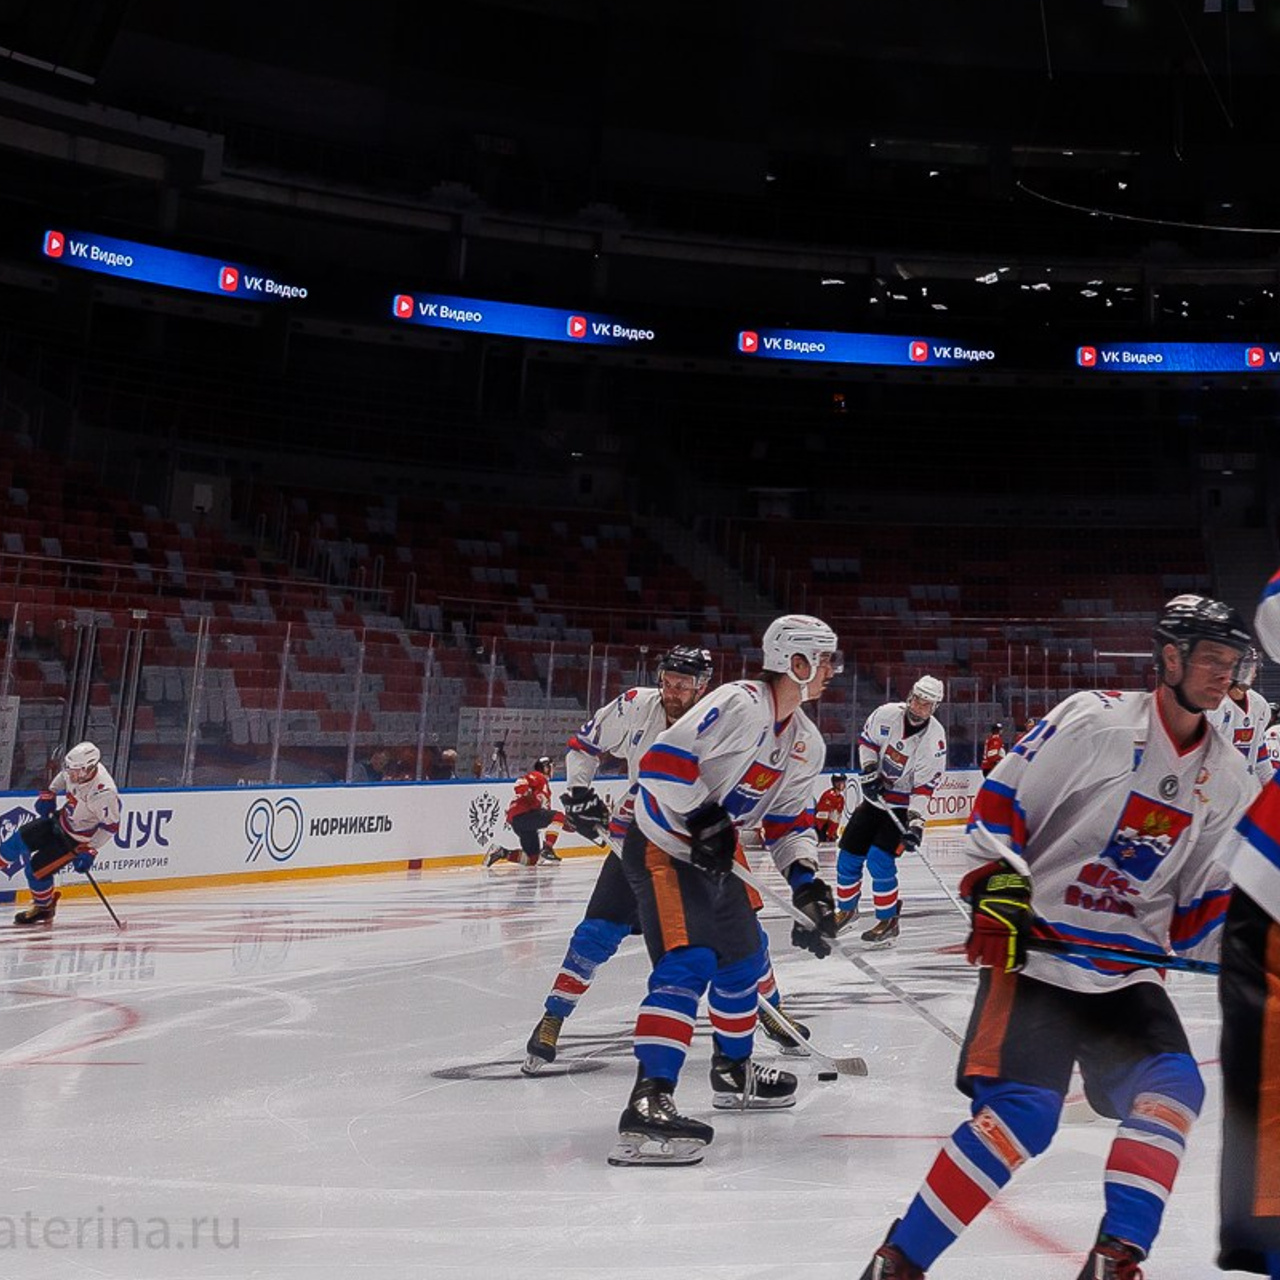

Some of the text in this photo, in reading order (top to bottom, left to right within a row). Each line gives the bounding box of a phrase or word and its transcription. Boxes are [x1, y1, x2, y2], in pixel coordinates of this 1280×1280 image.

[70, 241, 133, 266] VK Видео
[244, 276, 307, 298] VK Видео
[419, 303, 482, 322] VK Видео
[592, 323, 654, 340] VK Видео
[764, 338, 825, 353] VK Видео
[933, 347, 994, 361] VK Видео
[1102, 351, 1162, 364] VK Видео
[926, 795, 976, 815] СПОРТ
[245, 796, 393, 863] 90 НОРНИКЕЛЬ
[113, 857, 169, 871] ТЕРРИТОРИЯ
